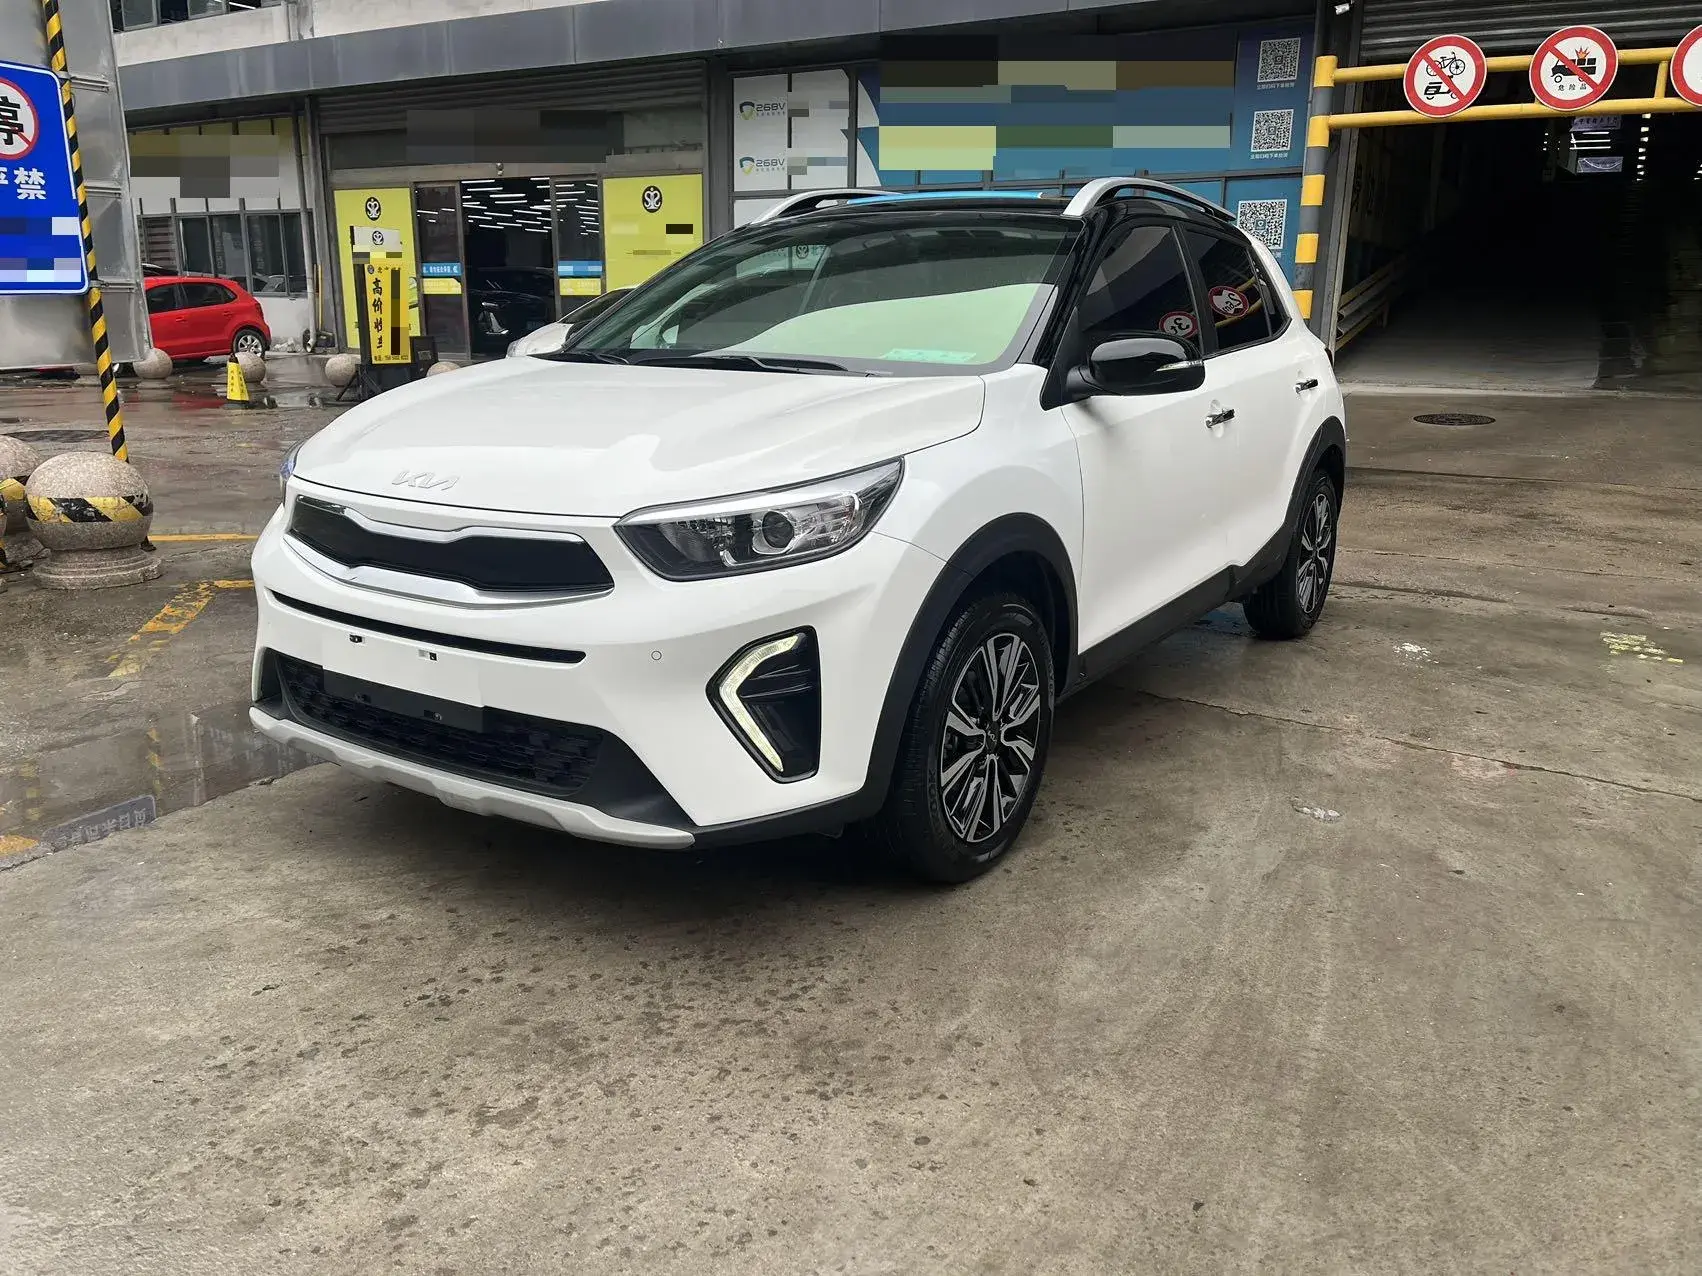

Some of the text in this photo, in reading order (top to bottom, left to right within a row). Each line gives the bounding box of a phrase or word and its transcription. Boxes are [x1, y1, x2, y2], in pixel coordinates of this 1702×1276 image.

[1558, 83, 1587, 91] 危险品
[0, 167, 46, 199] 禁
